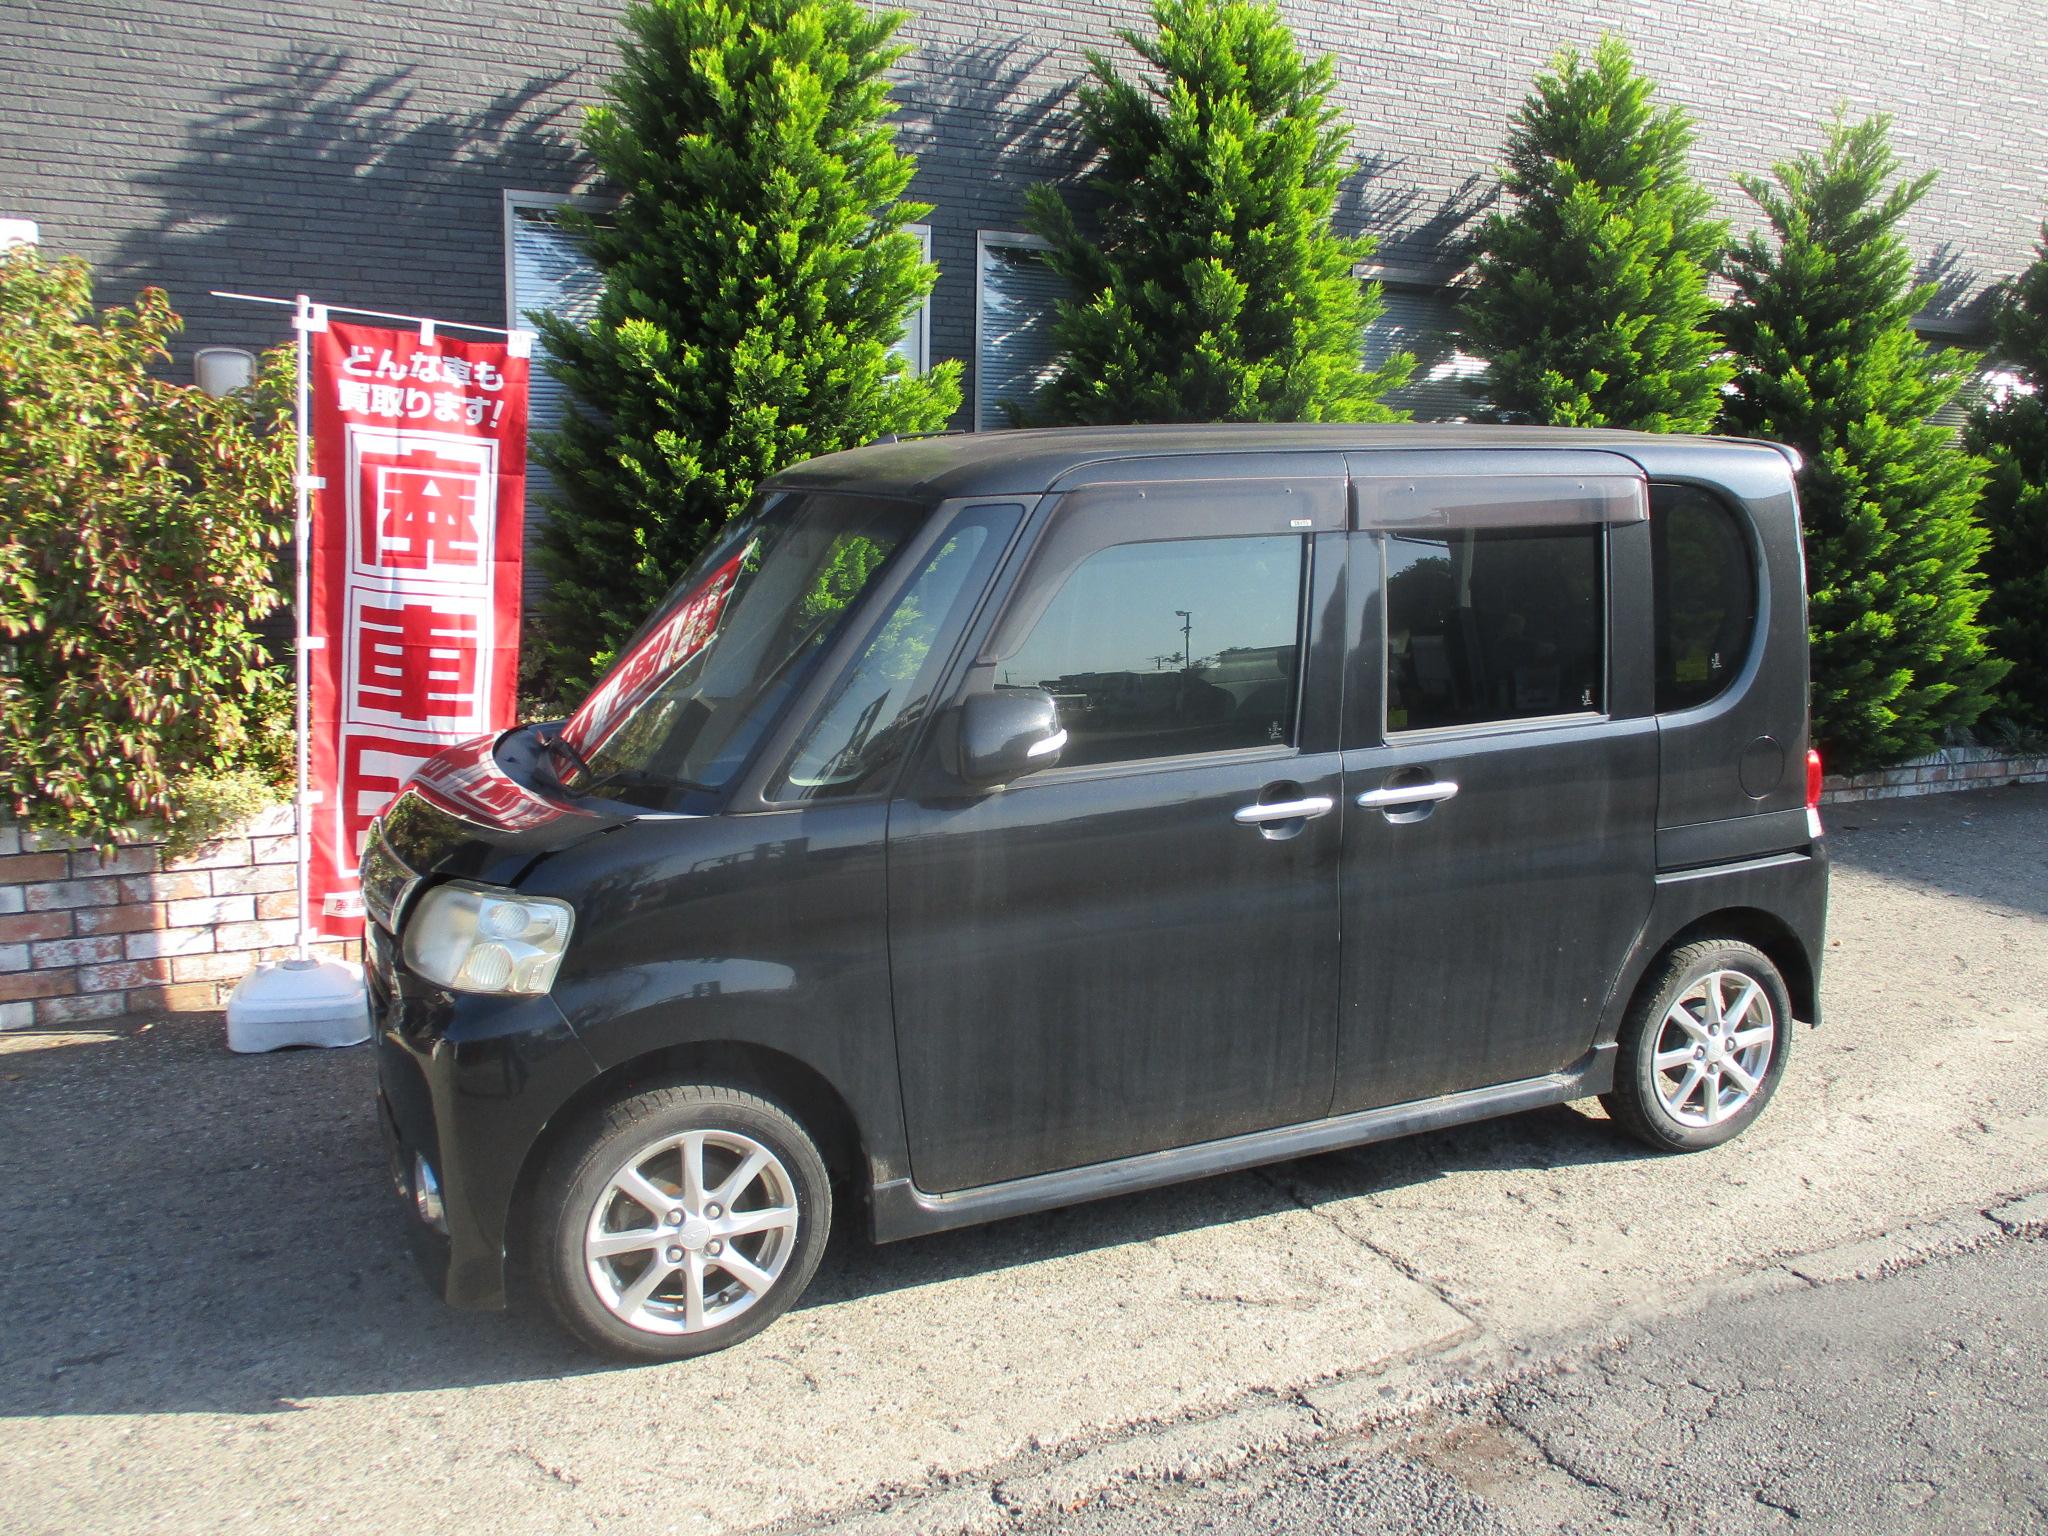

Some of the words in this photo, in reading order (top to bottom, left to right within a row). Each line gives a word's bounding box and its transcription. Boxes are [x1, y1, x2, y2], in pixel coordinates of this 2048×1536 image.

[342, 345, 504, 391] どんな車も
[337, 379, 504, 428] 買取ります!
[356, 449, 484, 857] 廃車
